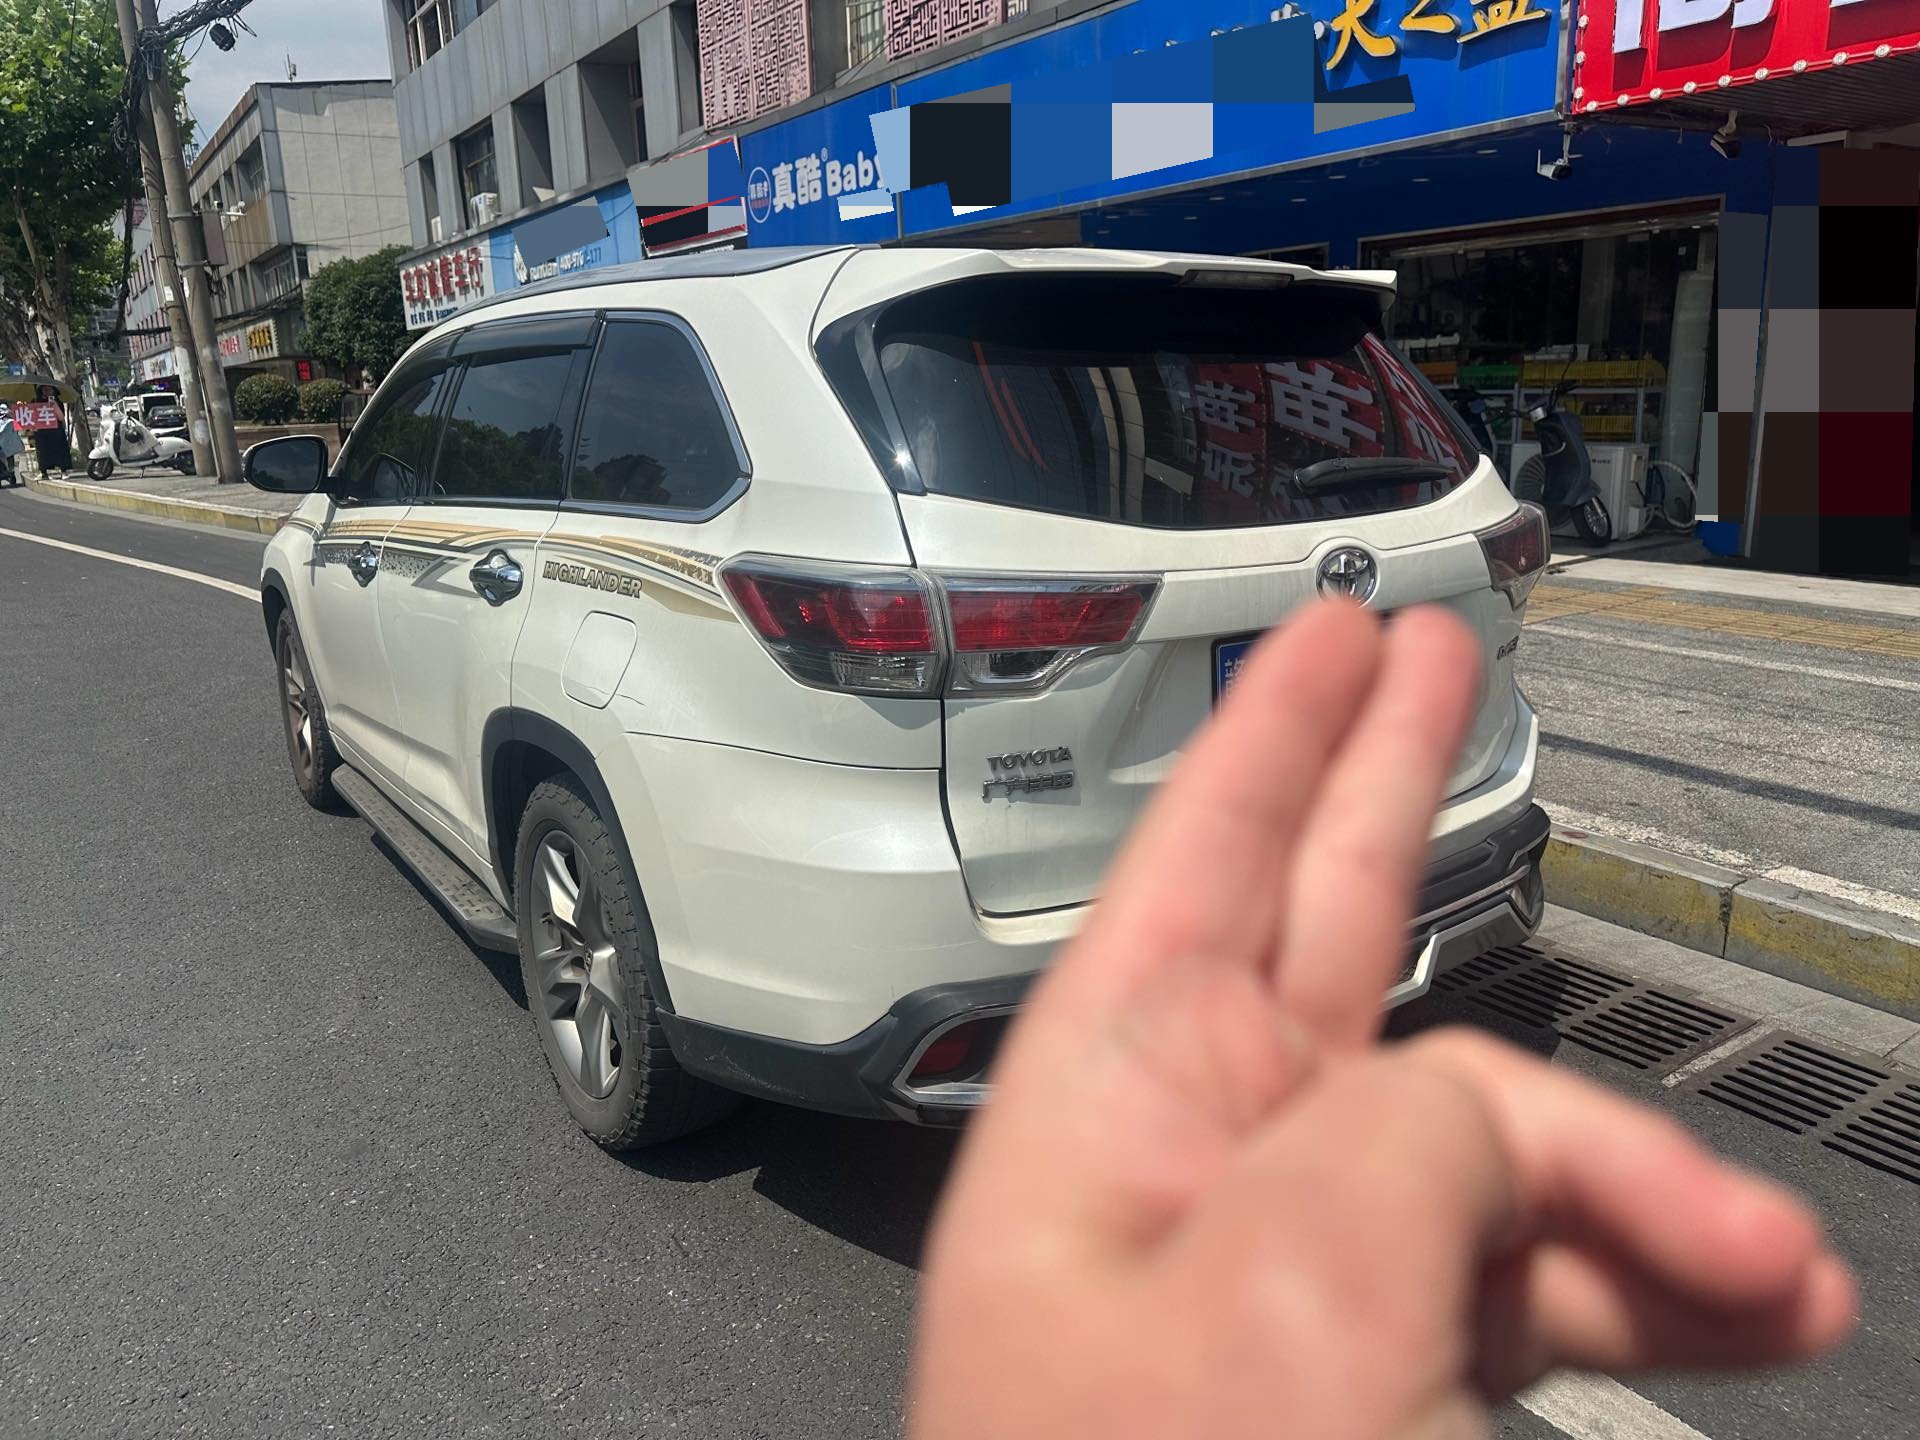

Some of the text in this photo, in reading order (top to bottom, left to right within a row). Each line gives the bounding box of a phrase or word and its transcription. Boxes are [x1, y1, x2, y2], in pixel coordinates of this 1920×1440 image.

[772, 153, 822, 214] 真酷
[15, 405, 56, 426] 收车
[542, 561, 642, 598] HIGHLANDER
[986, 746, 1073, 771] TOYOTA
